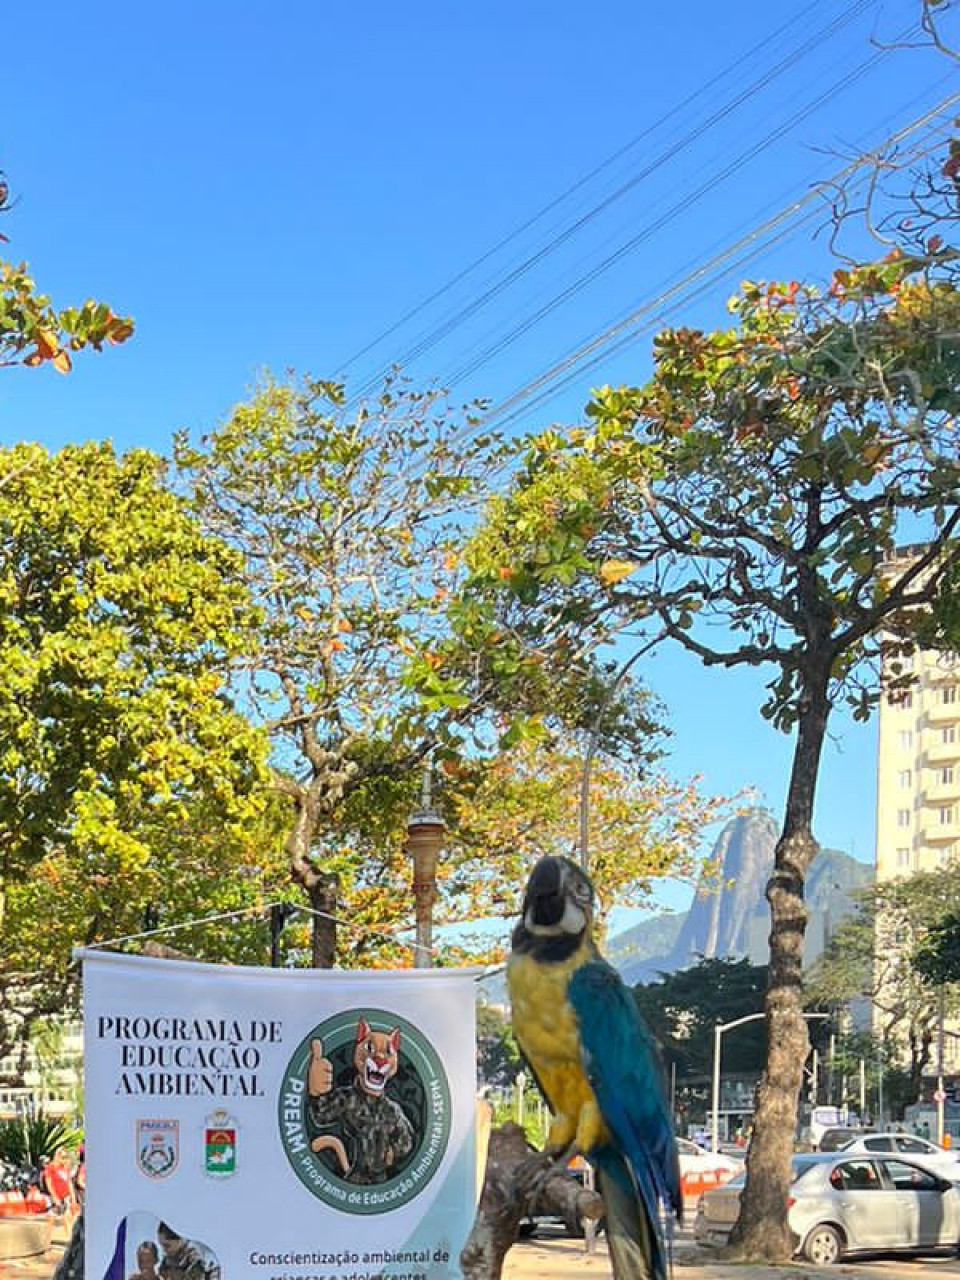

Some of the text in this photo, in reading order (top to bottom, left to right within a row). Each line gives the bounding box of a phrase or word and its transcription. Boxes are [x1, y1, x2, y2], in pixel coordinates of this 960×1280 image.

[97, 1015, 283, 1043] PROGRAMA DE
[120, 1040, 260, 1073] EDUCAÇÃO
[114, 1072, 265, 1097] AMBIENTAL
[284, 1078, 308, 1153] PREAM
[300, 1155, 347, 1201] Programa
[348, 1191, 362, 1204] de
[363, 1178, 414, 1204] Educação
[411, 1122, 444, 1181] Ambiental
[250, 1249, 450, 1267] Conscientização ambiental de
